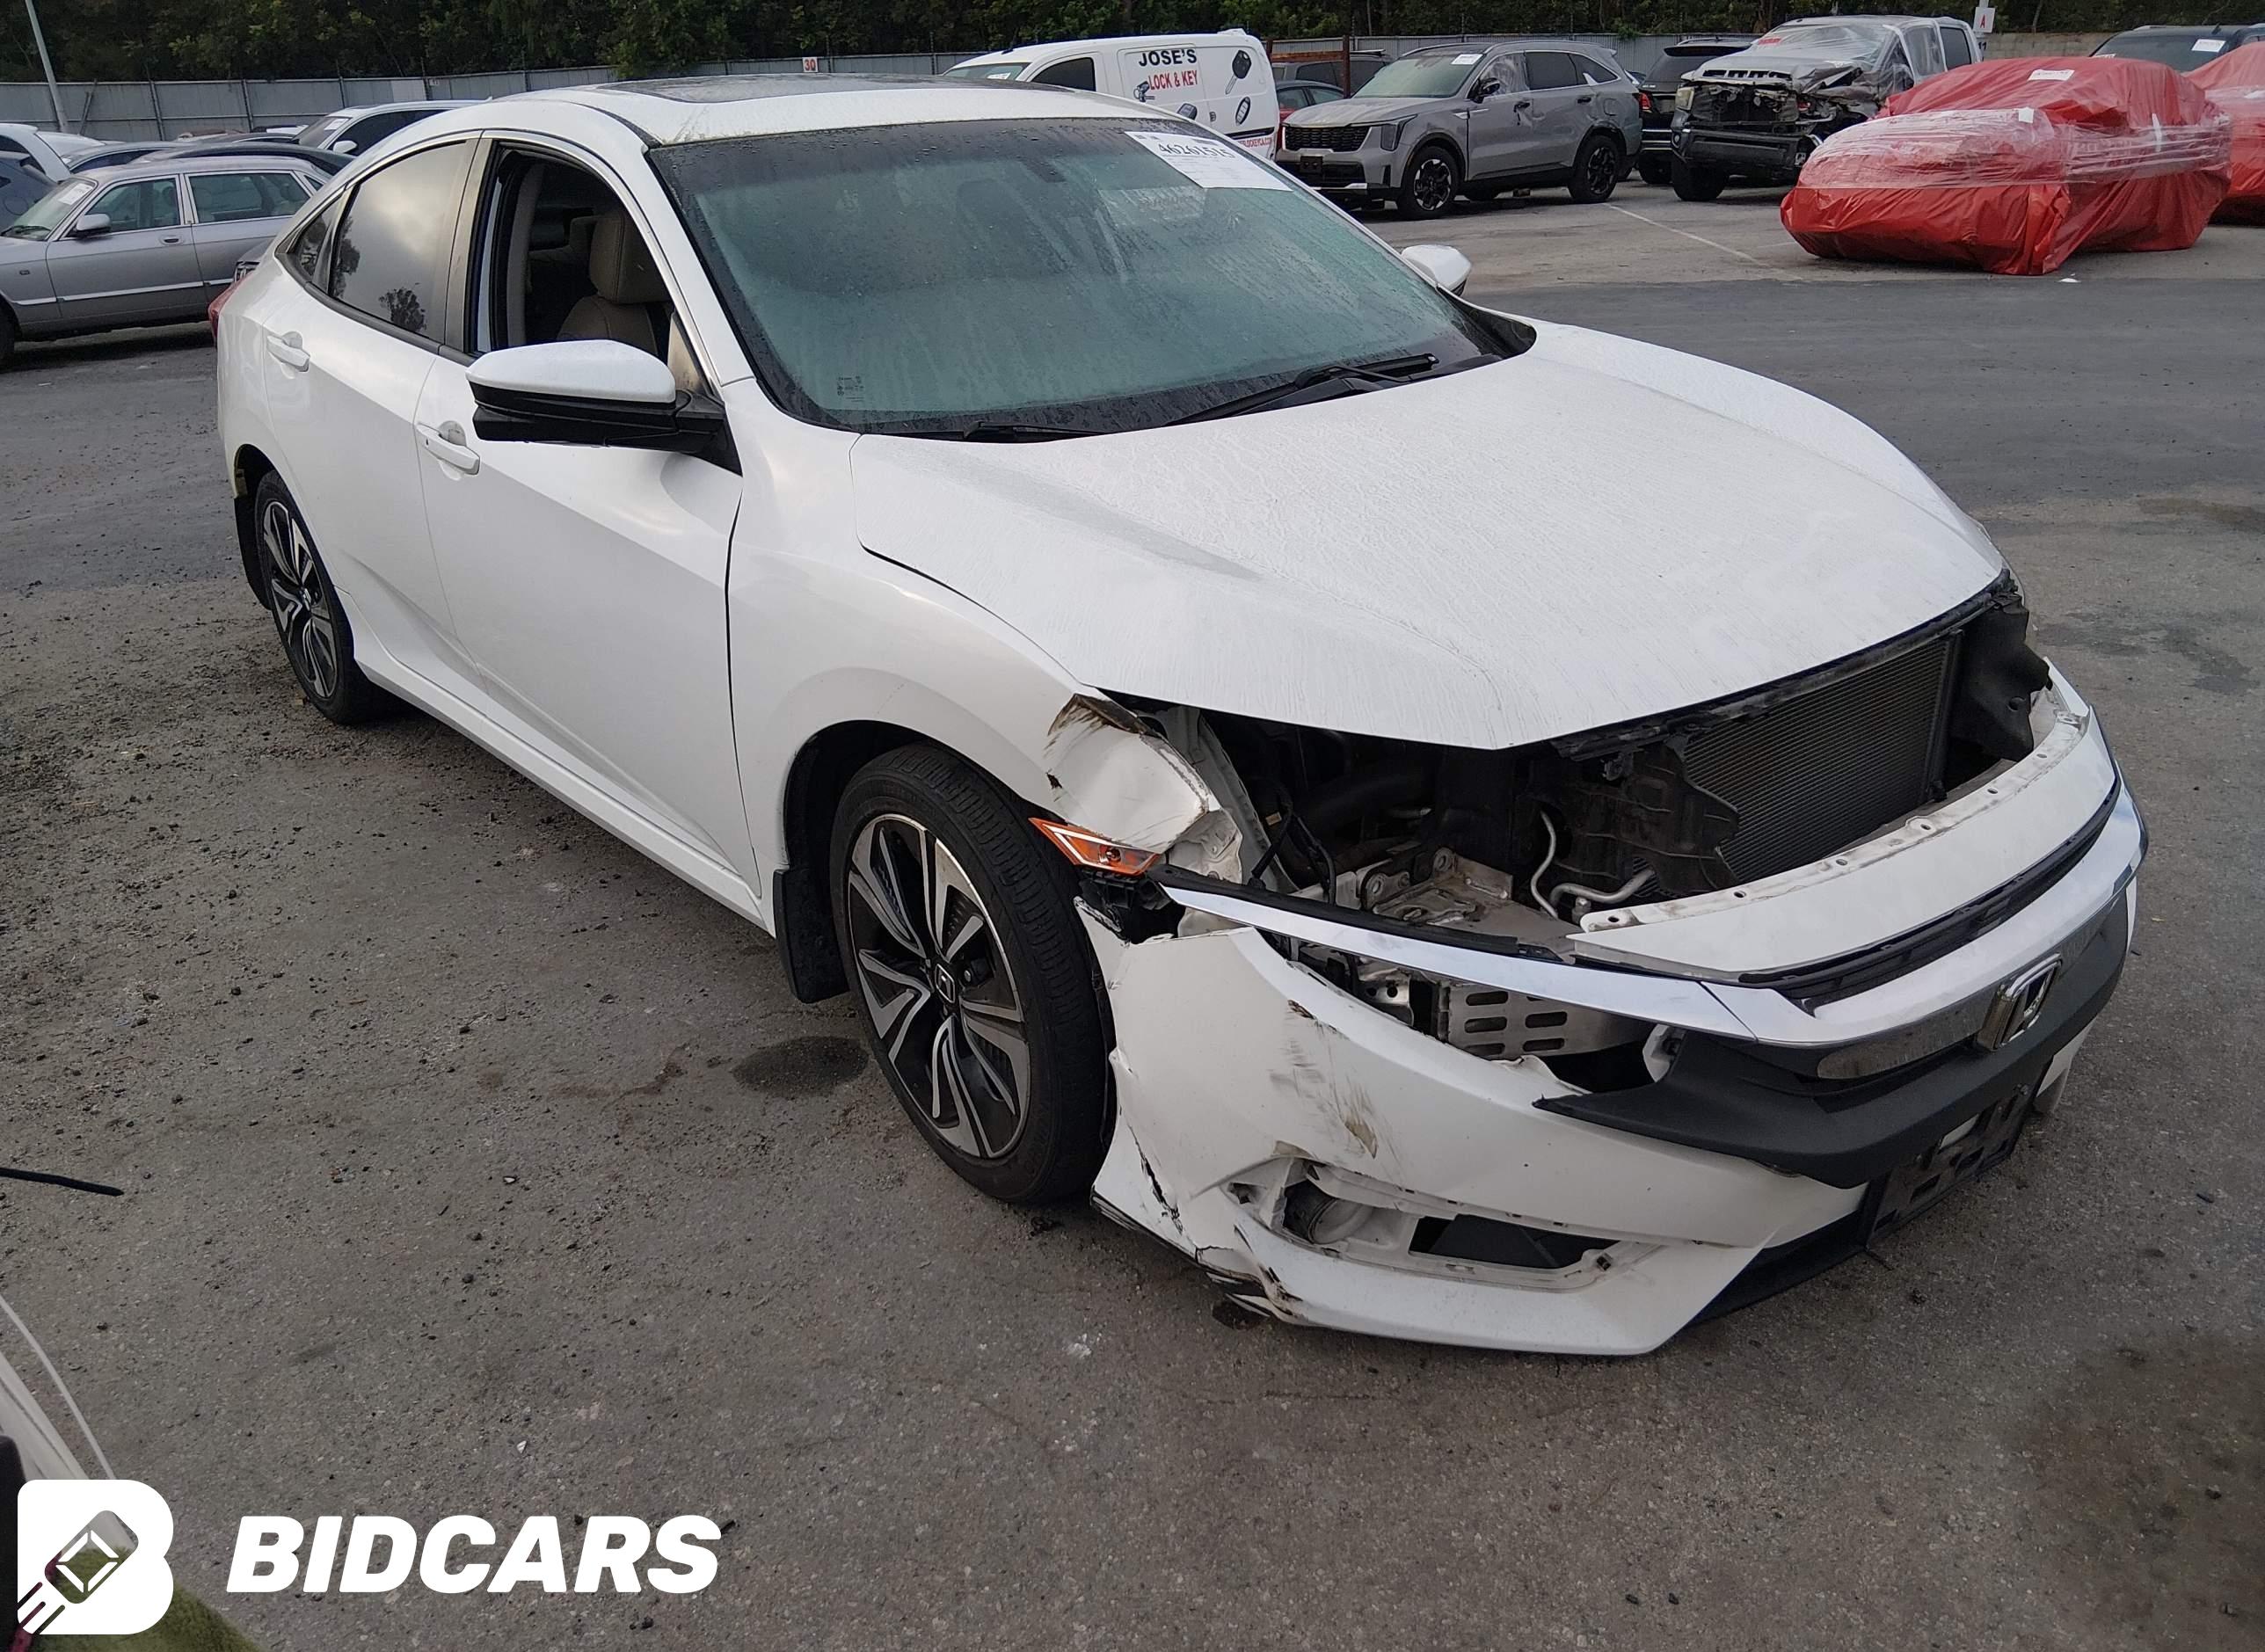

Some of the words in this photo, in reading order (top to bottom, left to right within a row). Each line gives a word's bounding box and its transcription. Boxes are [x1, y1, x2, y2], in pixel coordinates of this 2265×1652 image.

[1979, 14, 1985, 28] A
[805, 59, 816, 71] 30
[1139, 48, 1198, 67] JOSE'S
[1148, 72, 1172, 91] LOCK
[1174, 72, 1180, 87] &
[1182, 69, 1198, 86] KEY
